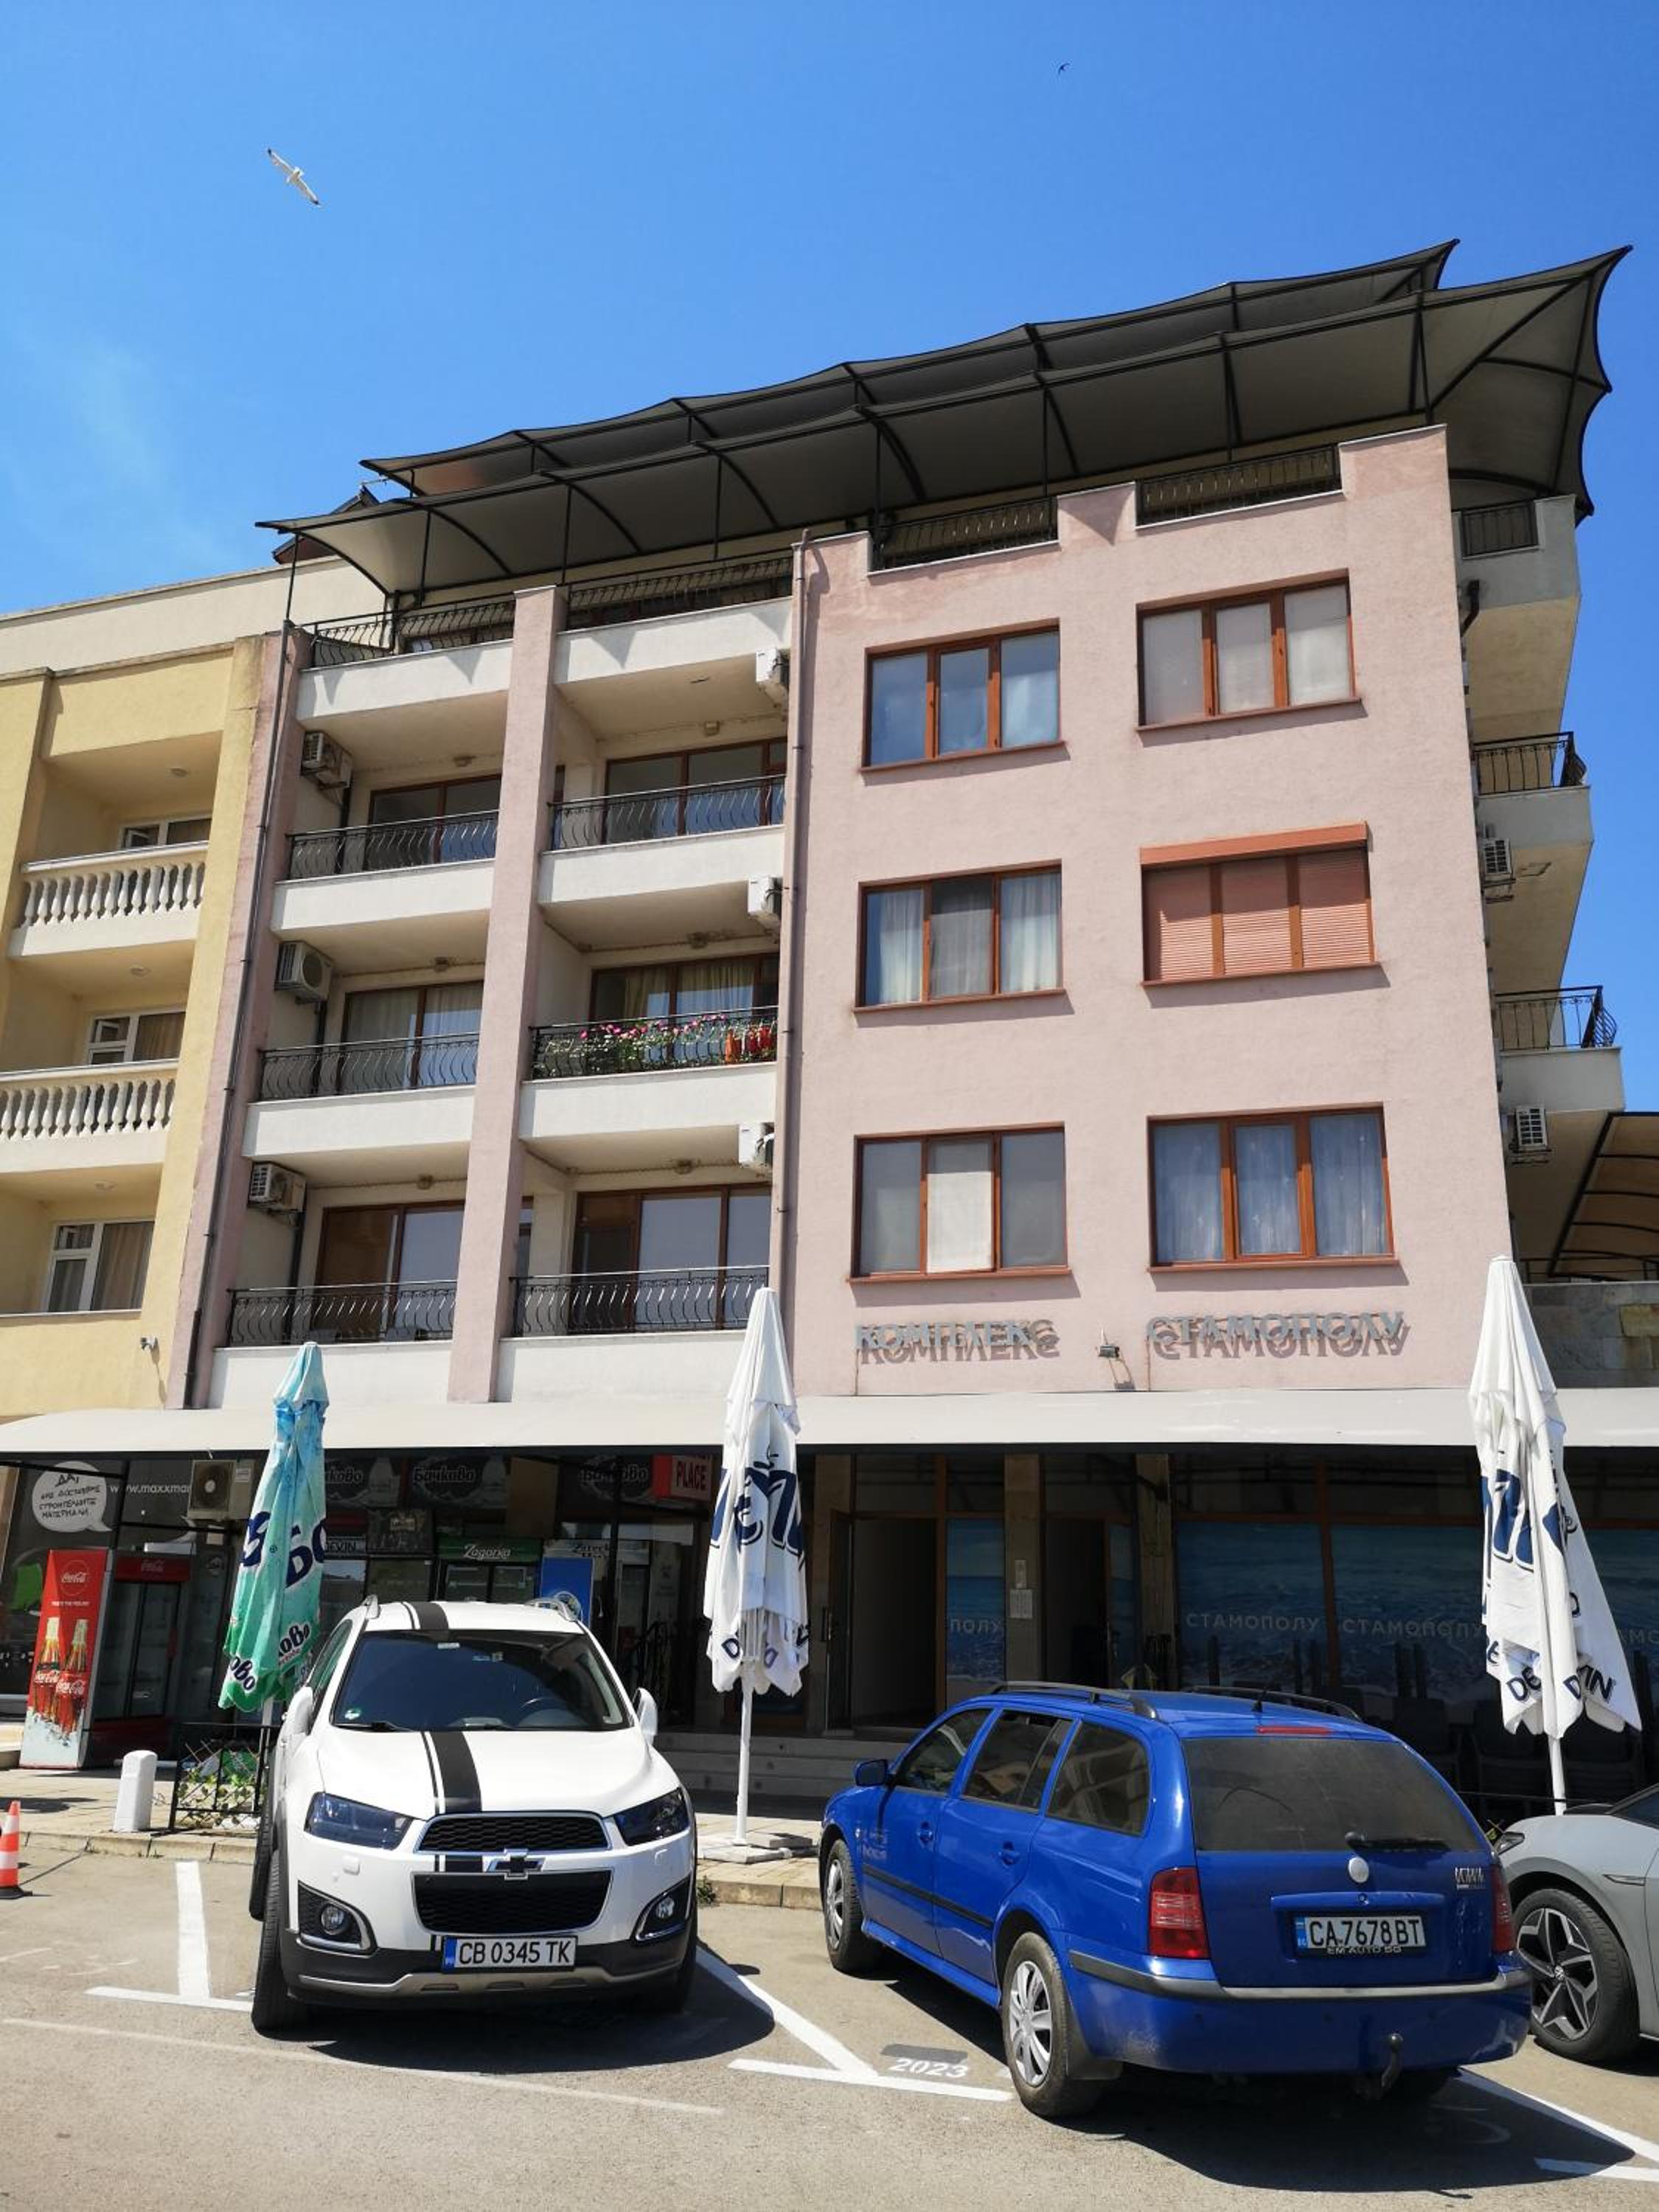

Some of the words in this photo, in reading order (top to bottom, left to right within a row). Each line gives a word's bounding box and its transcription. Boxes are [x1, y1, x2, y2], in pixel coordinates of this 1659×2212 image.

[855, 1319, 1060, 1355] КОМПЛЕКС
[1148, 1312, 1405, 1346] СТАМОПОЛУ
[676, 1461, 707, 1491] PLACE
[462, 1544, 512, 1561] Zagorka
[1186, 1612, 1321, 1633] СТАМОПОЛУ
[888, 2057, 968, 2078] 2023
